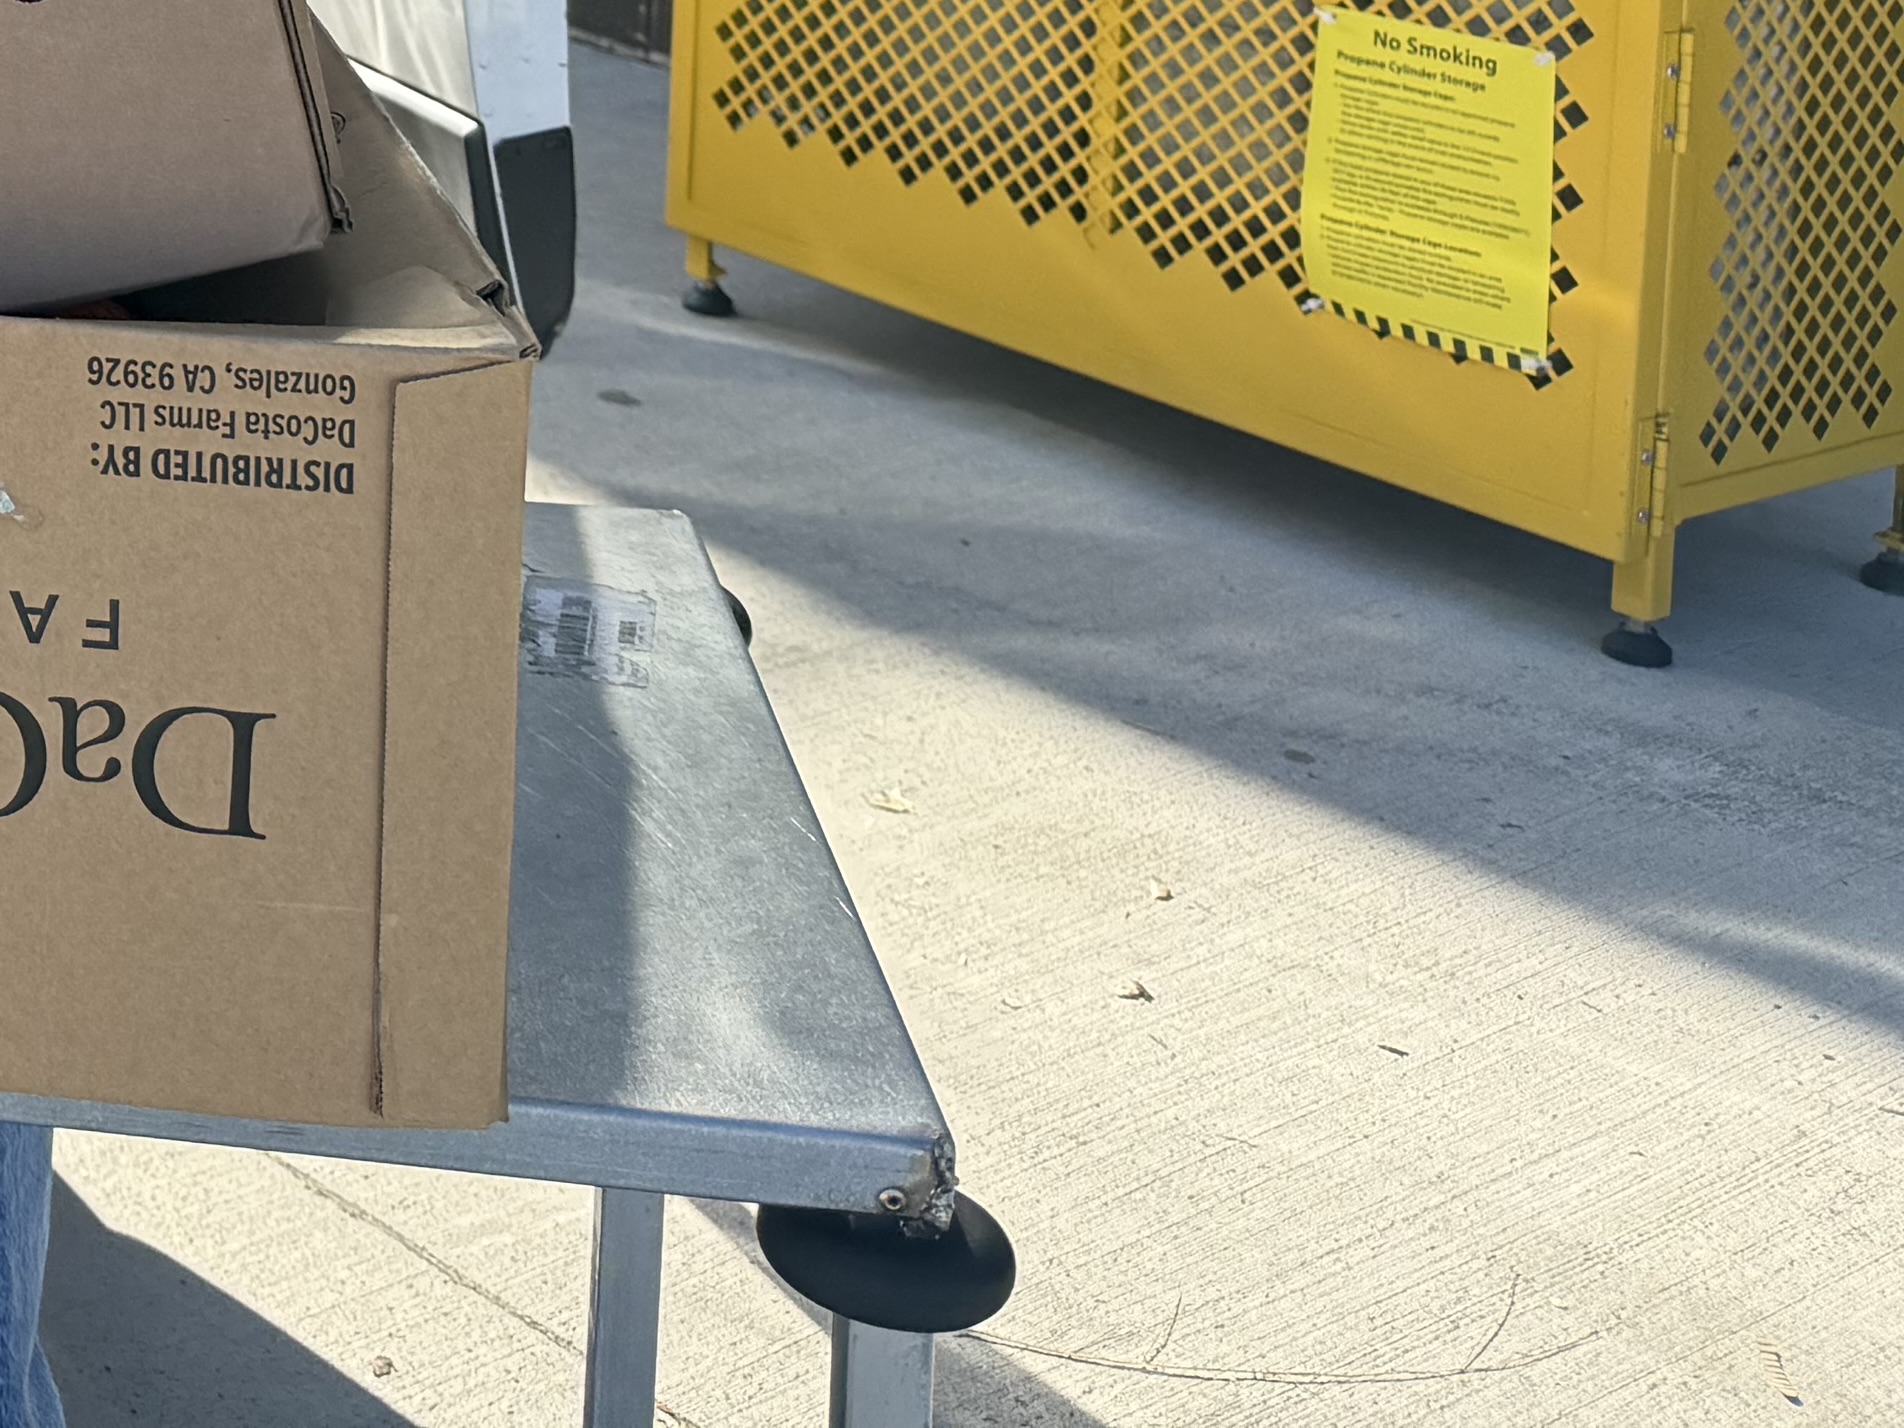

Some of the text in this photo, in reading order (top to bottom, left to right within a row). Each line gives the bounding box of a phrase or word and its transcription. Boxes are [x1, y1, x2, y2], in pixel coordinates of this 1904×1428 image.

[1336, 49, 1487, 93] Propane Cylinder Storage
[1373, 29, 1499, 78] No Smoking
[86, 355, 357, 405] Gonzales, CA 93926
[99, 399, 356, 449] DaCosta Farms LLC
[90, 441, 355, 495] DISTRIBUTED BY:
